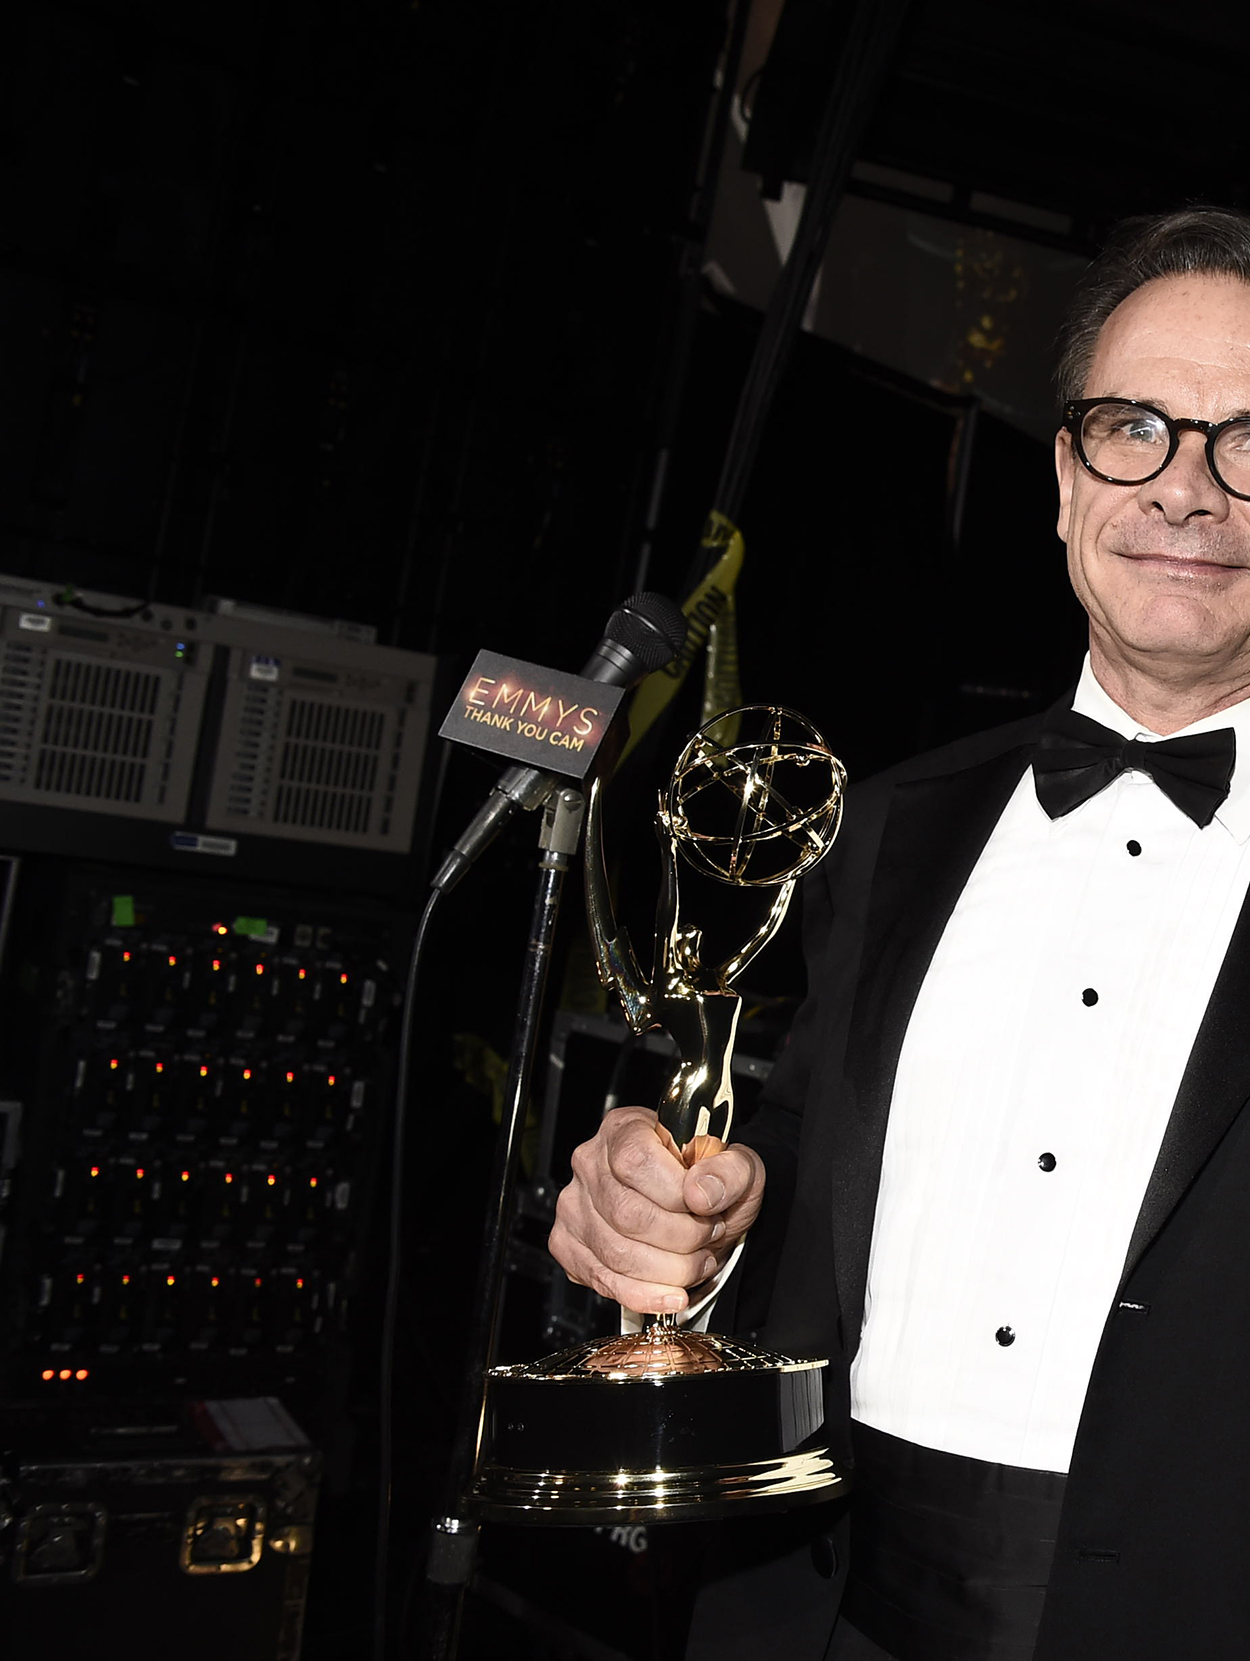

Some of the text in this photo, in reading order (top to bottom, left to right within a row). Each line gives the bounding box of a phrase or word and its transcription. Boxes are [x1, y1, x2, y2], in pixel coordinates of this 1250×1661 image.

[463, 705, 585, 752] THANK YOU CAM
[468, 676, 598, 735] EMMYS
